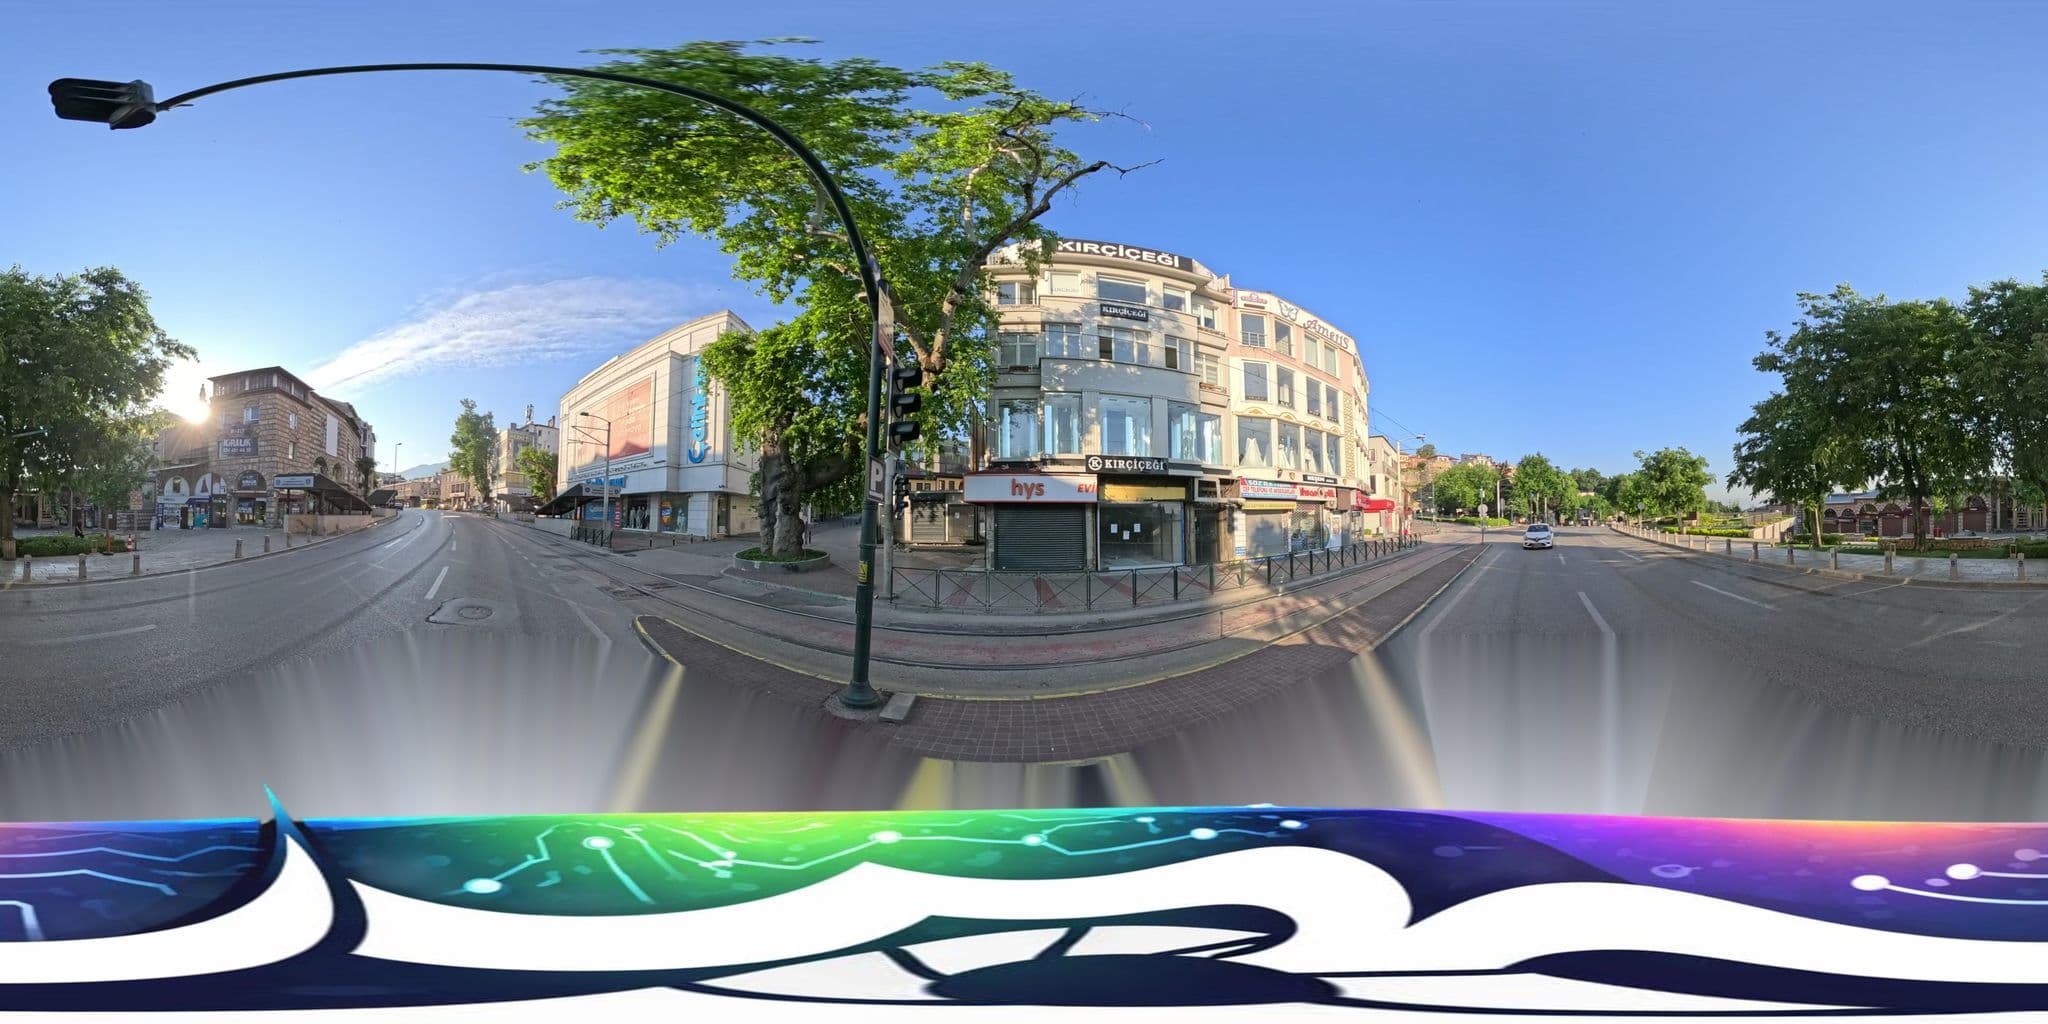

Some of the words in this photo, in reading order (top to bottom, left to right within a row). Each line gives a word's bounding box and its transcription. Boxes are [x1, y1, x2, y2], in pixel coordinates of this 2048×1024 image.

[1057, 240, 1180, 268] KIRÇİÇEĞİ
[870, 461, 884, 491] P
[1104, 458, 1164, 471] KIRÇİÇEĞİ
[1011, 478, 1045, 499] hys
